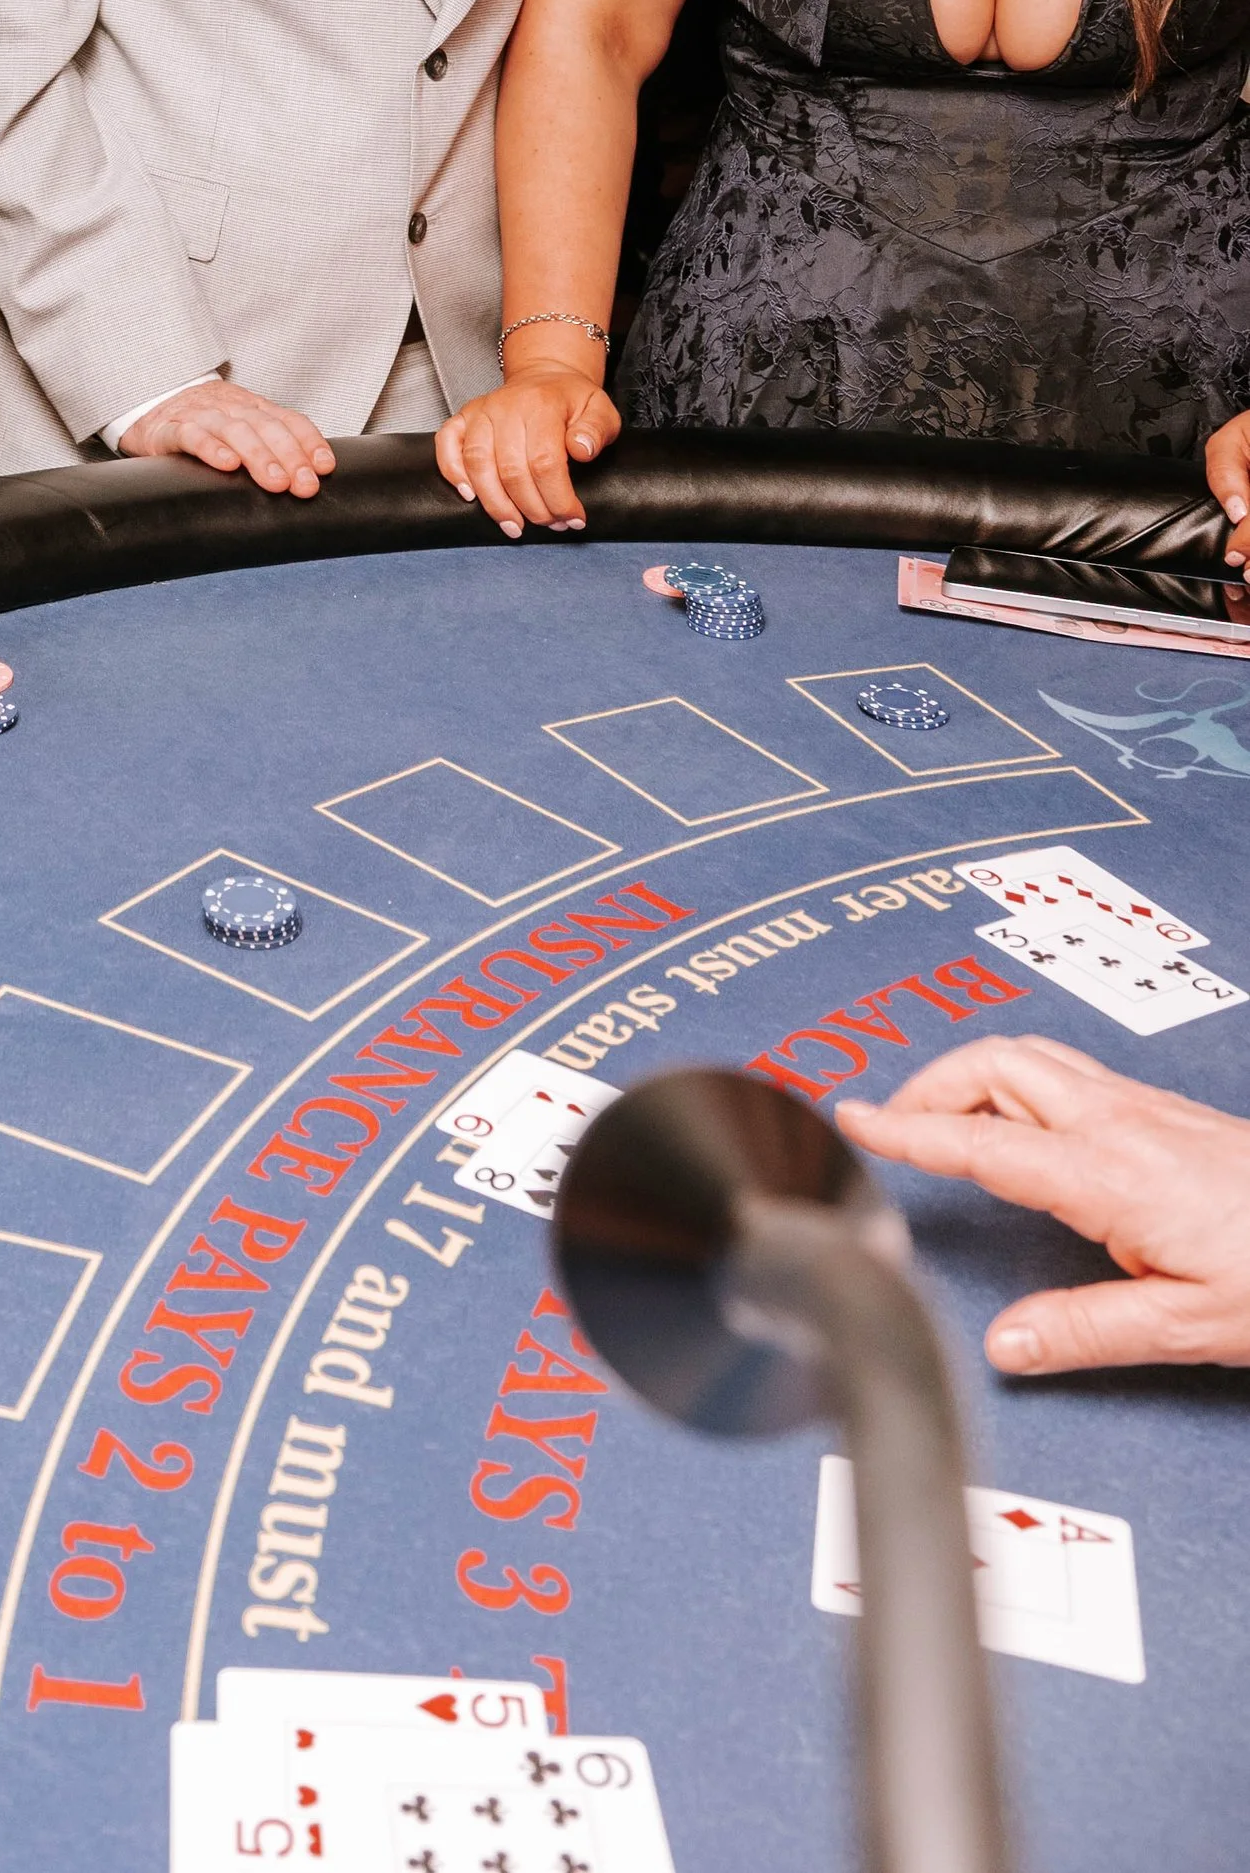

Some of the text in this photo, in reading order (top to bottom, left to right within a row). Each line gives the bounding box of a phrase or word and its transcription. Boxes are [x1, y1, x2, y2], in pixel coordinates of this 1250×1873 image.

[969, 868, 1003, 887] 9
[988, 928, 1028, 948] 3
[1192, 977, 1234, 1000] 3
[454, 1114, 493, 1137] 9
[475, 1168, 515, 1190] 8
[242, 864, 968, 1643] aler must stan 17 and must
[28, 881, 695, 1711] INSURANCE PAYS 2 to 1
[1060, 1515, 1114, 1544] A
[456, 1549, 571, 1615] 3
[471, 1694, 528, 1728] 5
[576, 1752, 632, 1789] 6
[236, 1818, 294, 1857] 5
